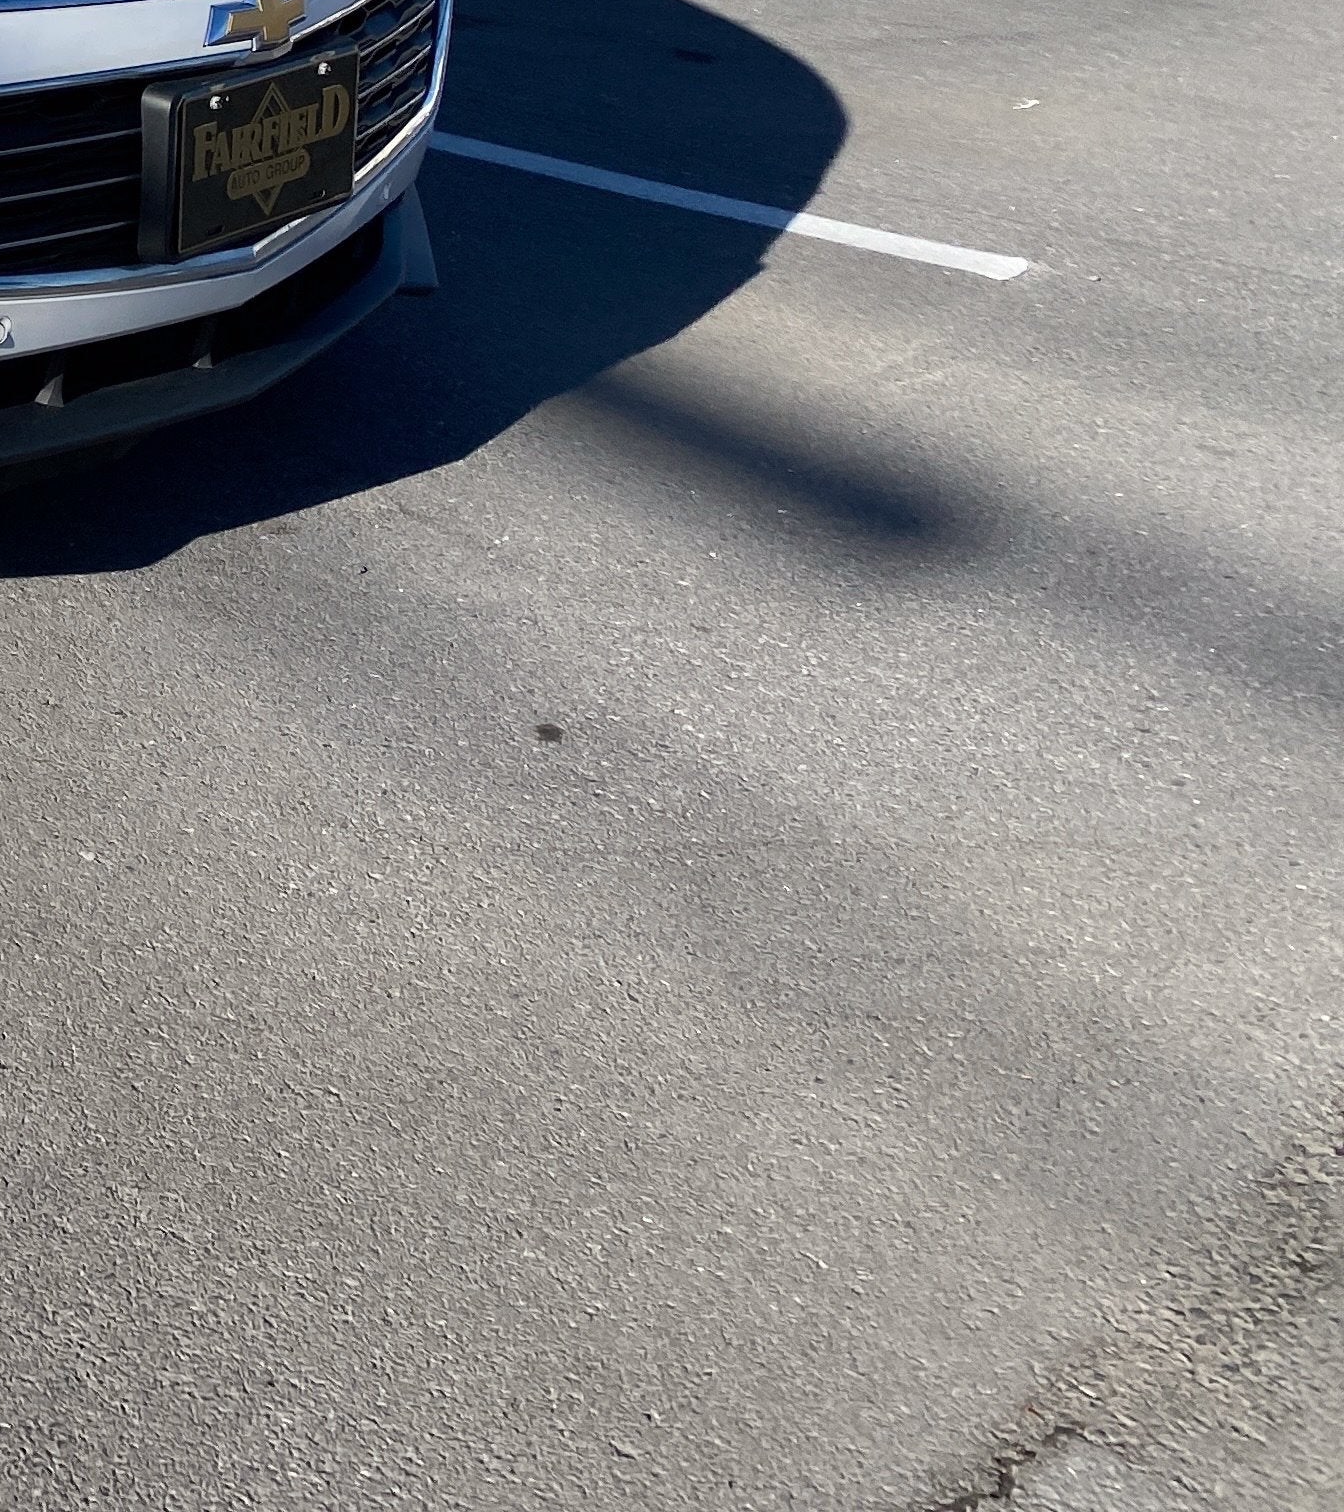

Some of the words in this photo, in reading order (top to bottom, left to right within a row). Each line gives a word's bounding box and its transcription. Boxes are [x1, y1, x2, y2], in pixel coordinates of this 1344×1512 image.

[192, 84, 351, 183] FAIRFIELD
[231, 170, 261, 191] AUTO
[265, 153, 306, 181] GROUP
